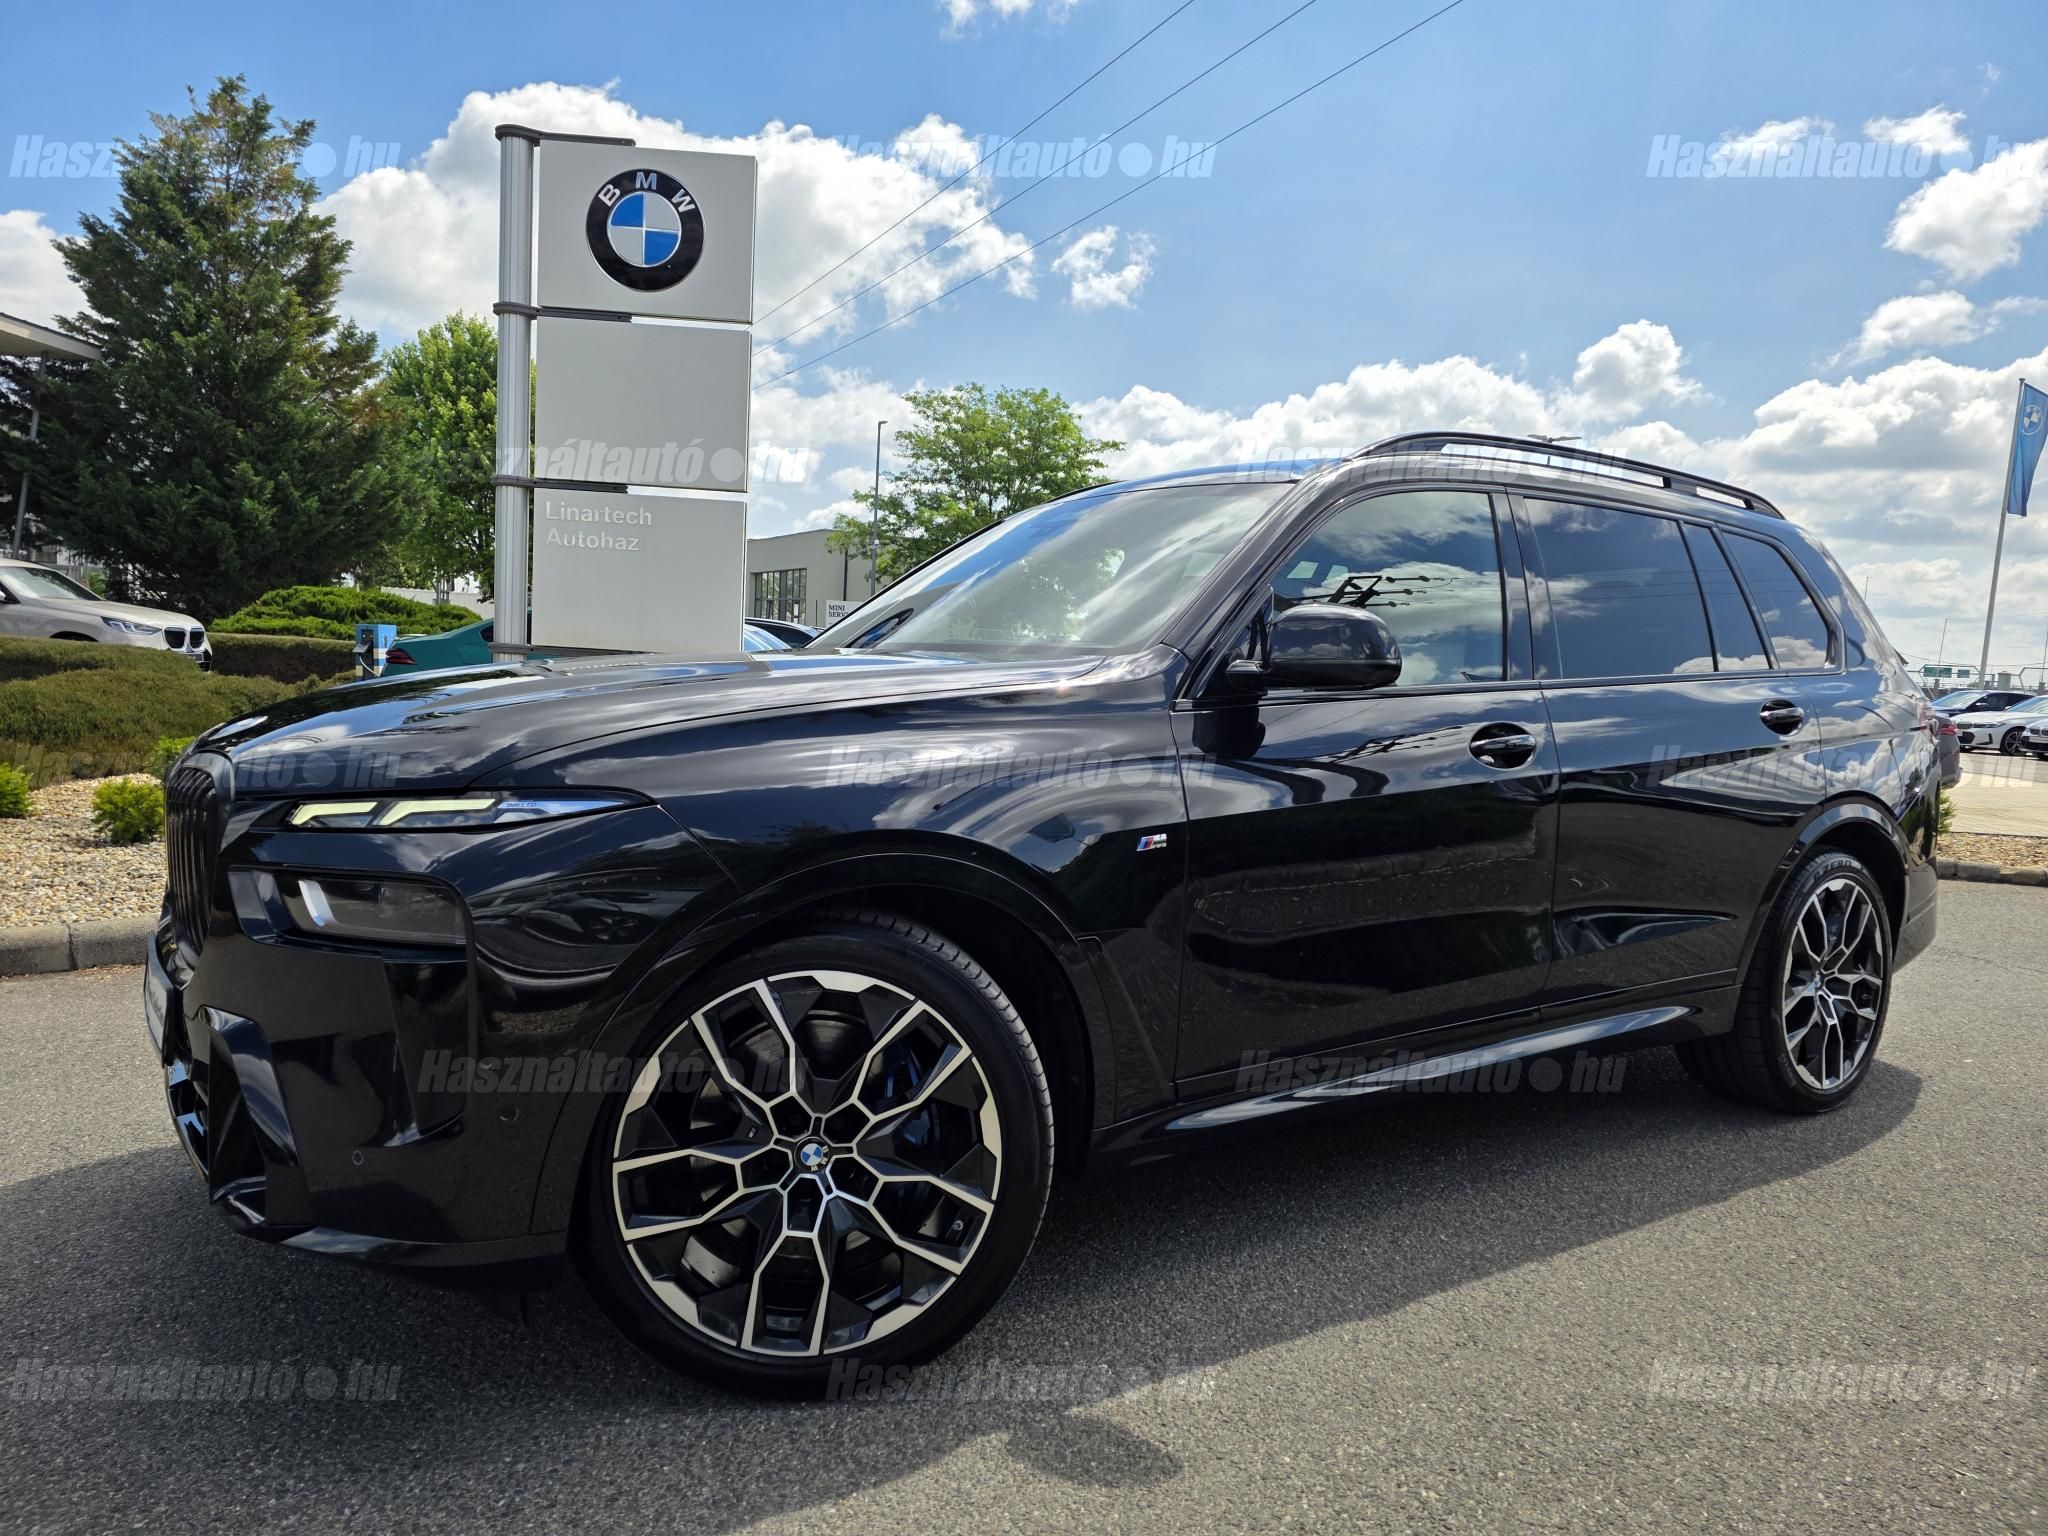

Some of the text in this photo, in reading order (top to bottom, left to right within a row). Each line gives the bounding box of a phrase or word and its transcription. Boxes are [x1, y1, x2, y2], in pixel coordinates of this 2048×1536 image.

[598, 171, 695, 213] BMW
[545, 501, 653, 526] Linartech
[545, 527, 641, 552] Autohaz
